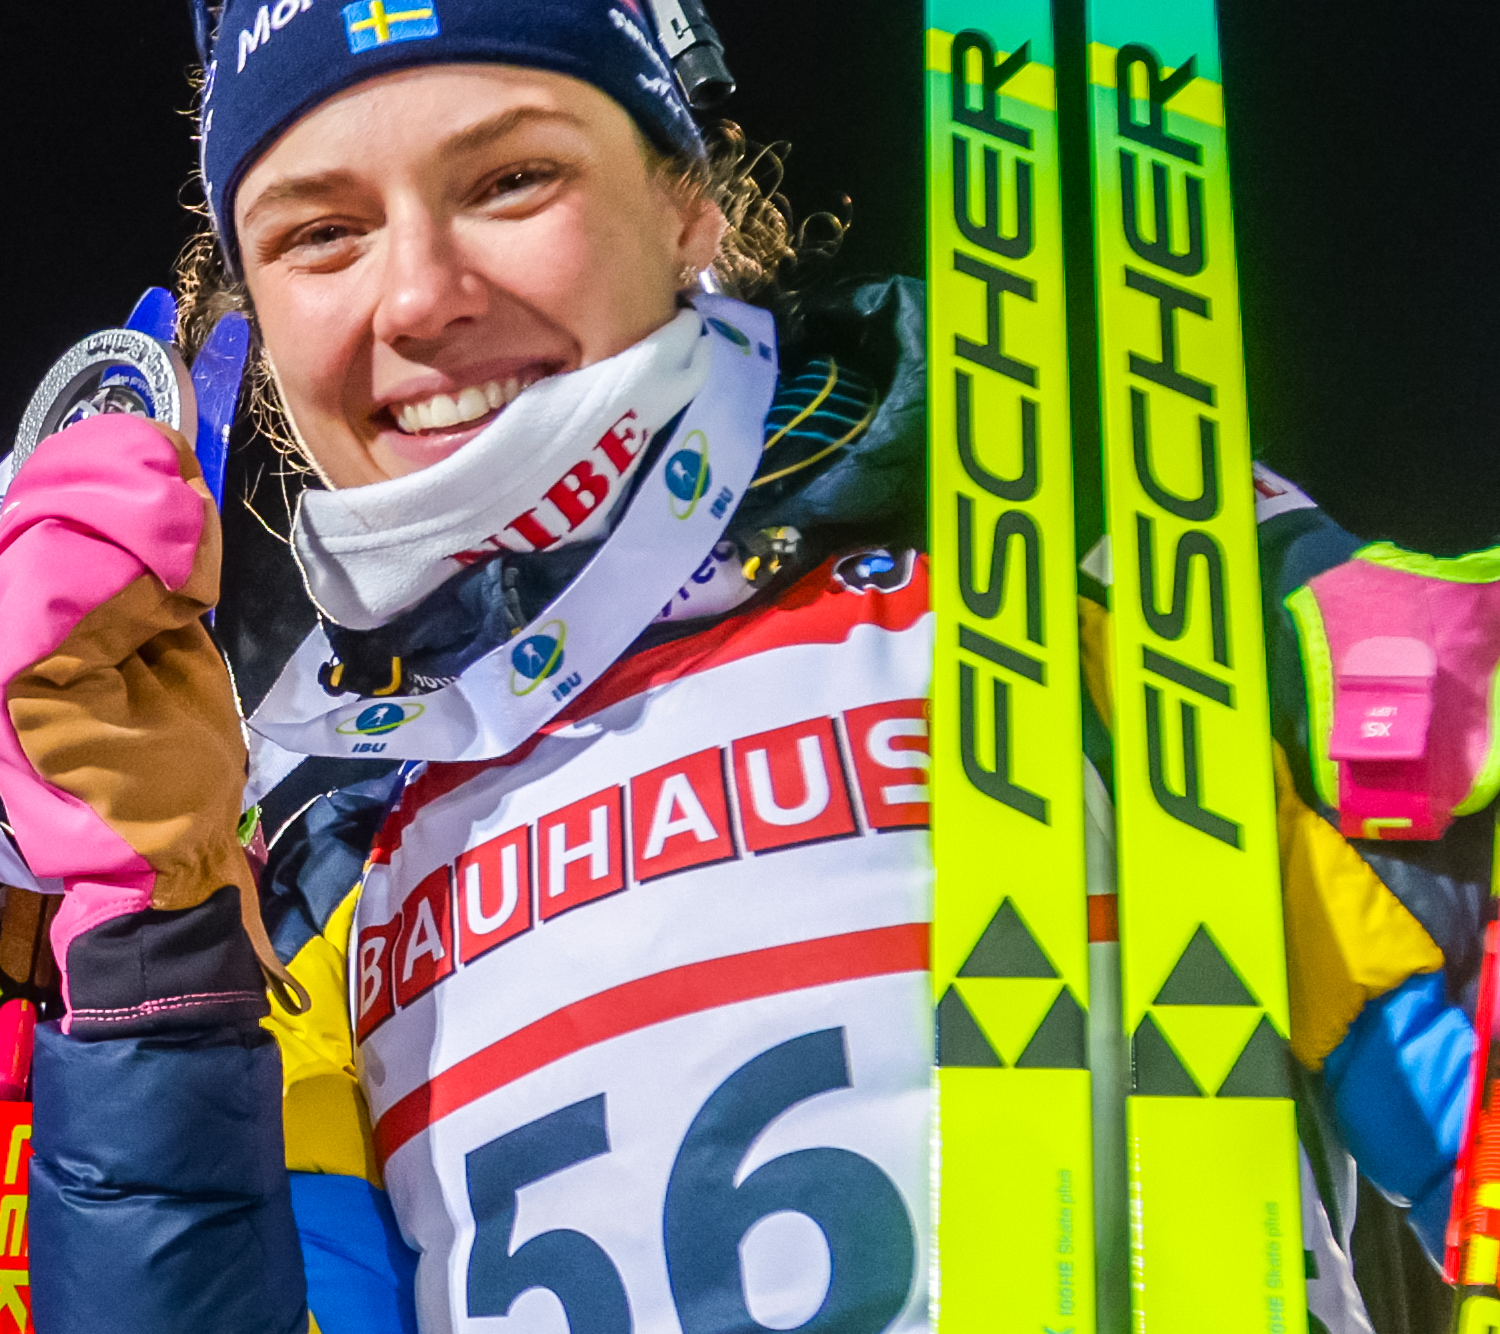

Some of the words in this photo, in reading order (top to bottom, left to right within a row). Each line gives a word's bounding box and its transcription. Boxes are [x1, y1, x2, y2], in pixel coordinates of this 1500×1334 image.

[950, 26, 1053, 829] FISCHER
[1115, 40, 1247, 852] FISCHER
[351, 742, 387, 753] IBU
[551, 671, 583, 703] IBU
[359, 722, 930, 1013] BAUHAUS
